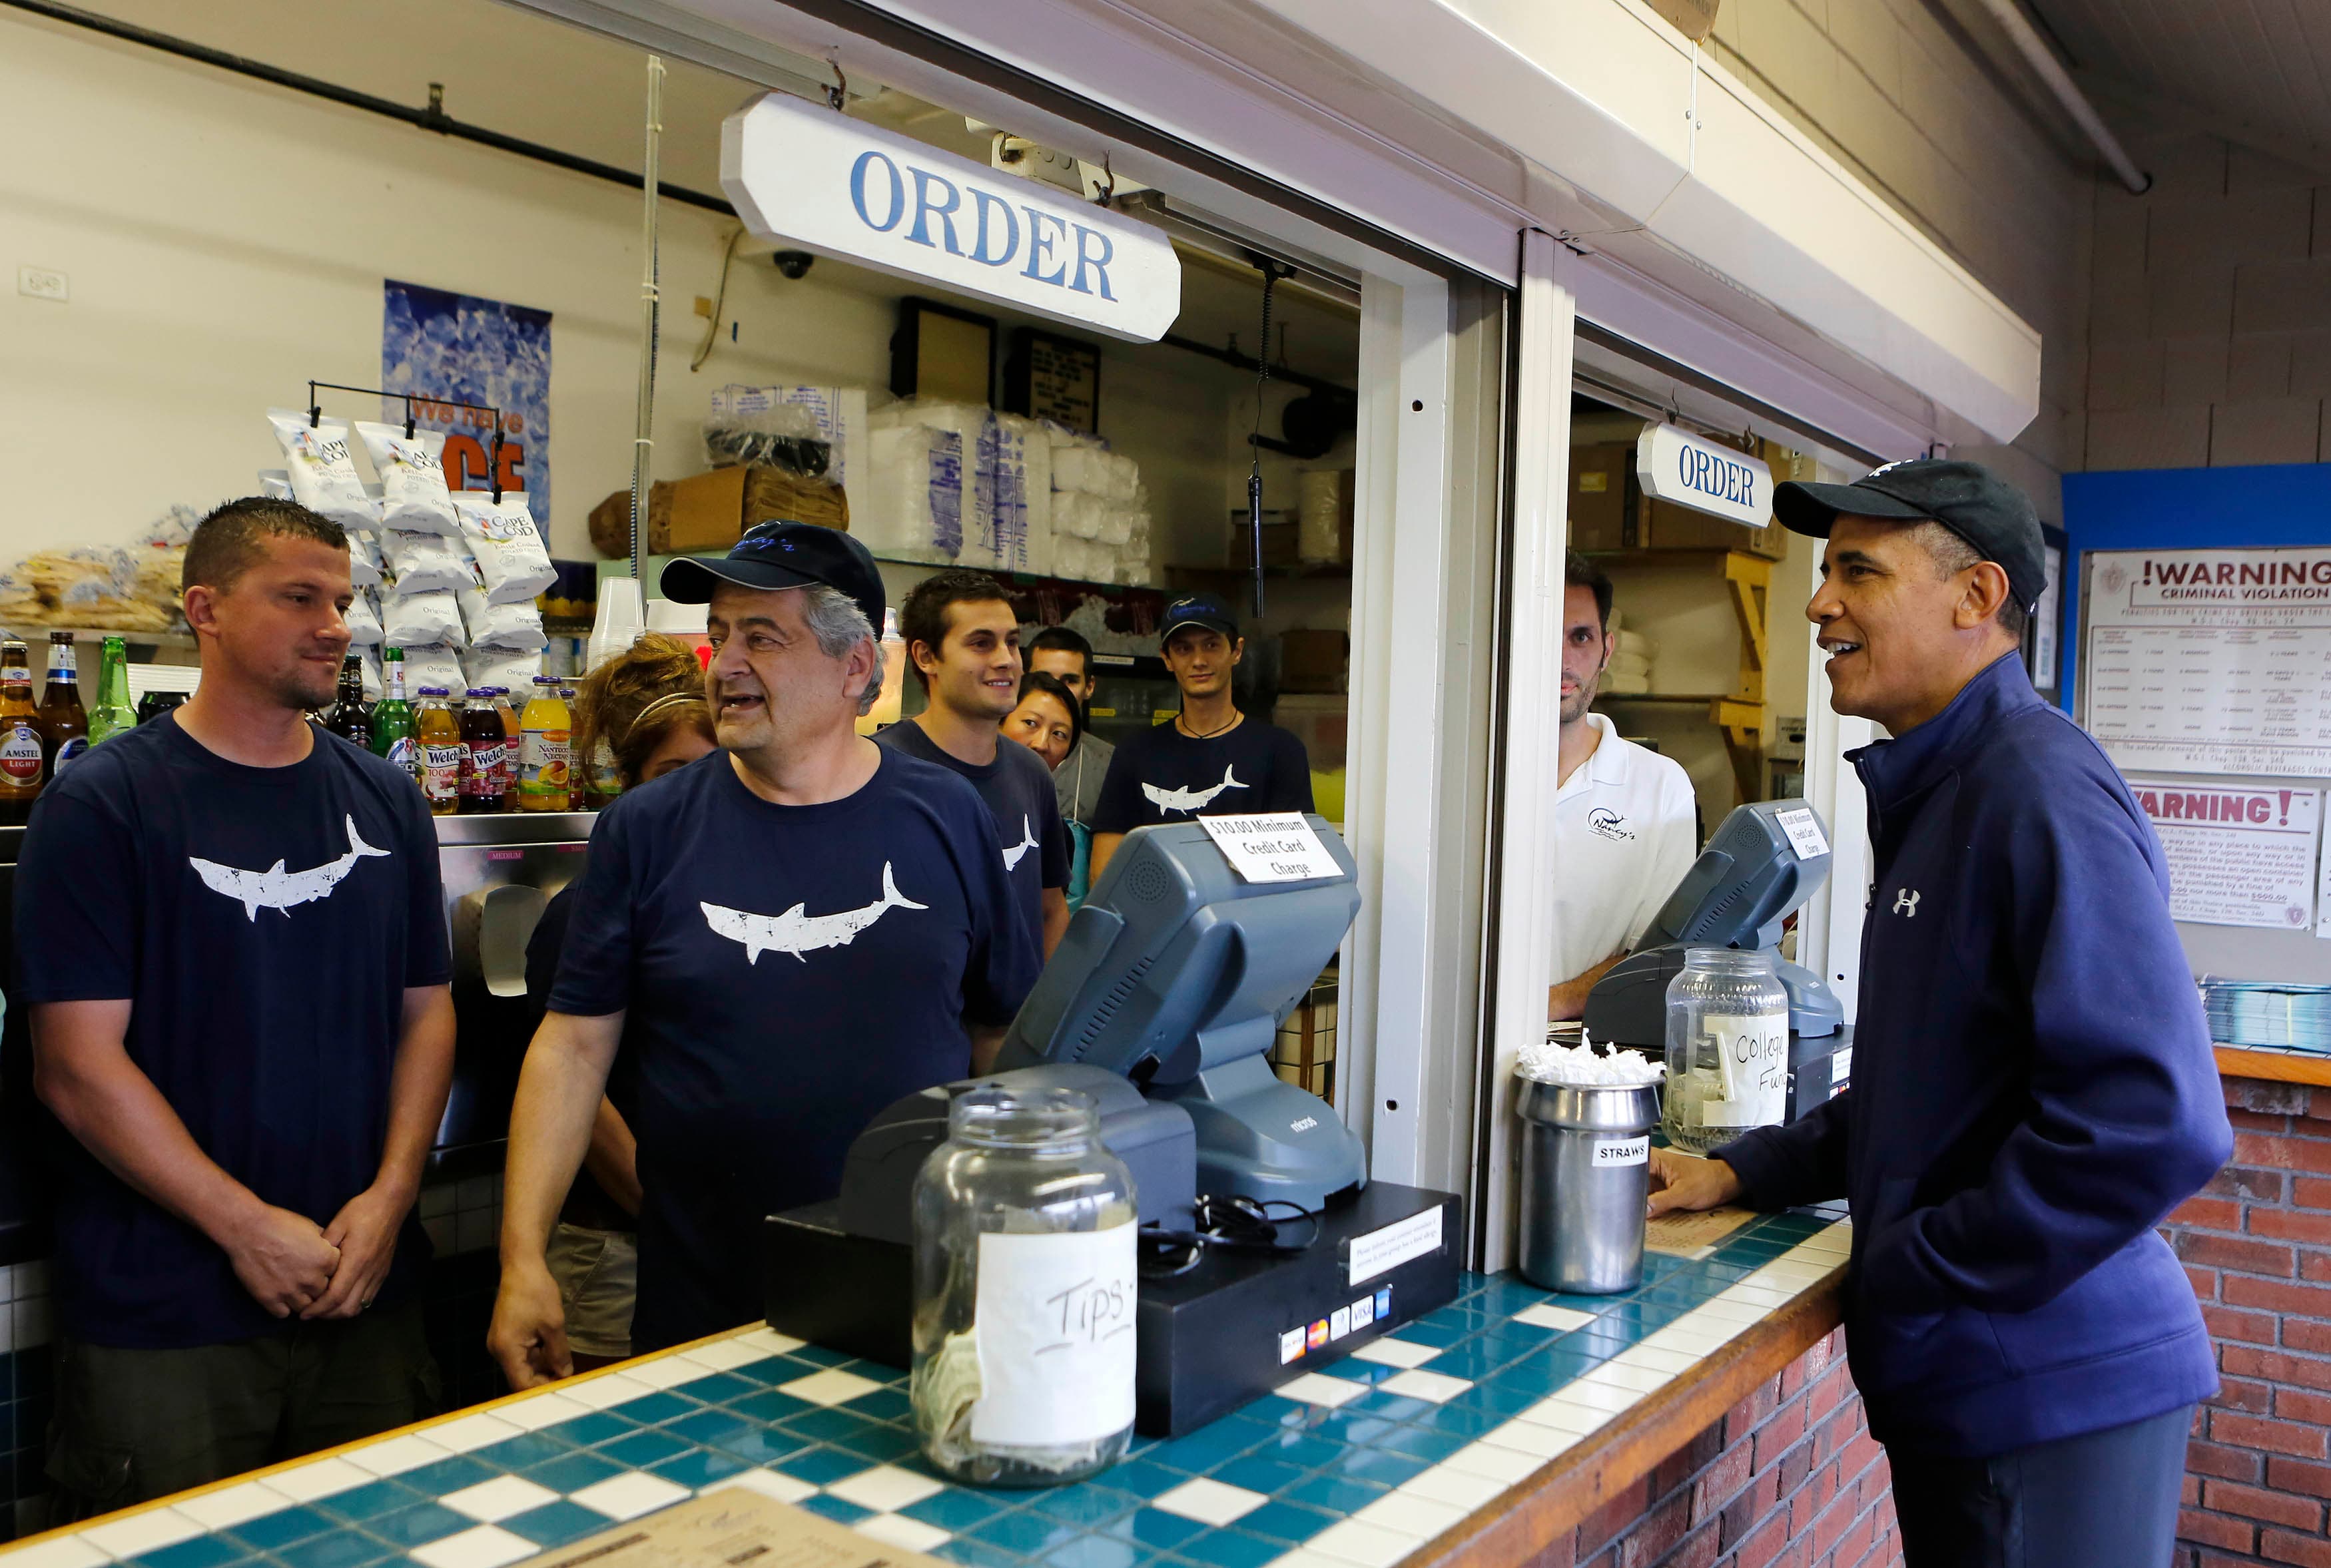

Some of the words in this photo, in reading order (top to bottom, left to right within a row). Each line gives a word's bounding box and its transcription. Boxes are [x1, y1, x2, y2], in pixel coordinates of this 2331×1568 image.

[850, 150, 1119, 304] ORDER
[410, 390, 454, 423] We
[462, 399, 523, 433] have
[1679, 444, 1755, 508] ORDER
[492, 515, 529, 527] CAPE
[503, 526, 534, 537] COD
[529, 564, 553, 573] Origina
[2161, 588, 2236, 599] CRIMINAL
[2242, 587, 2329, 600] VIOLATION
[422, 606, 450, 615] Original
[9, 759, 36, 768] LIGHT
[1209, 820, 1252, 835] $10.00
[1252, 819, 1305, 834] Minimum
[1593, 819, 1636, 840] Nancy's
[1243, 840, 1279, 856] Credit
[1279, 838, 1306, 853] Card
[1270, 862, 1311, 877] Charge
[1736, 1031, 1784, 1071] College
[1289, 1115, 1318, 1133] micros
[1600, 1145, 1644, 1159] STRAWS
[1354, 1302, 1372, 1322] VISA
